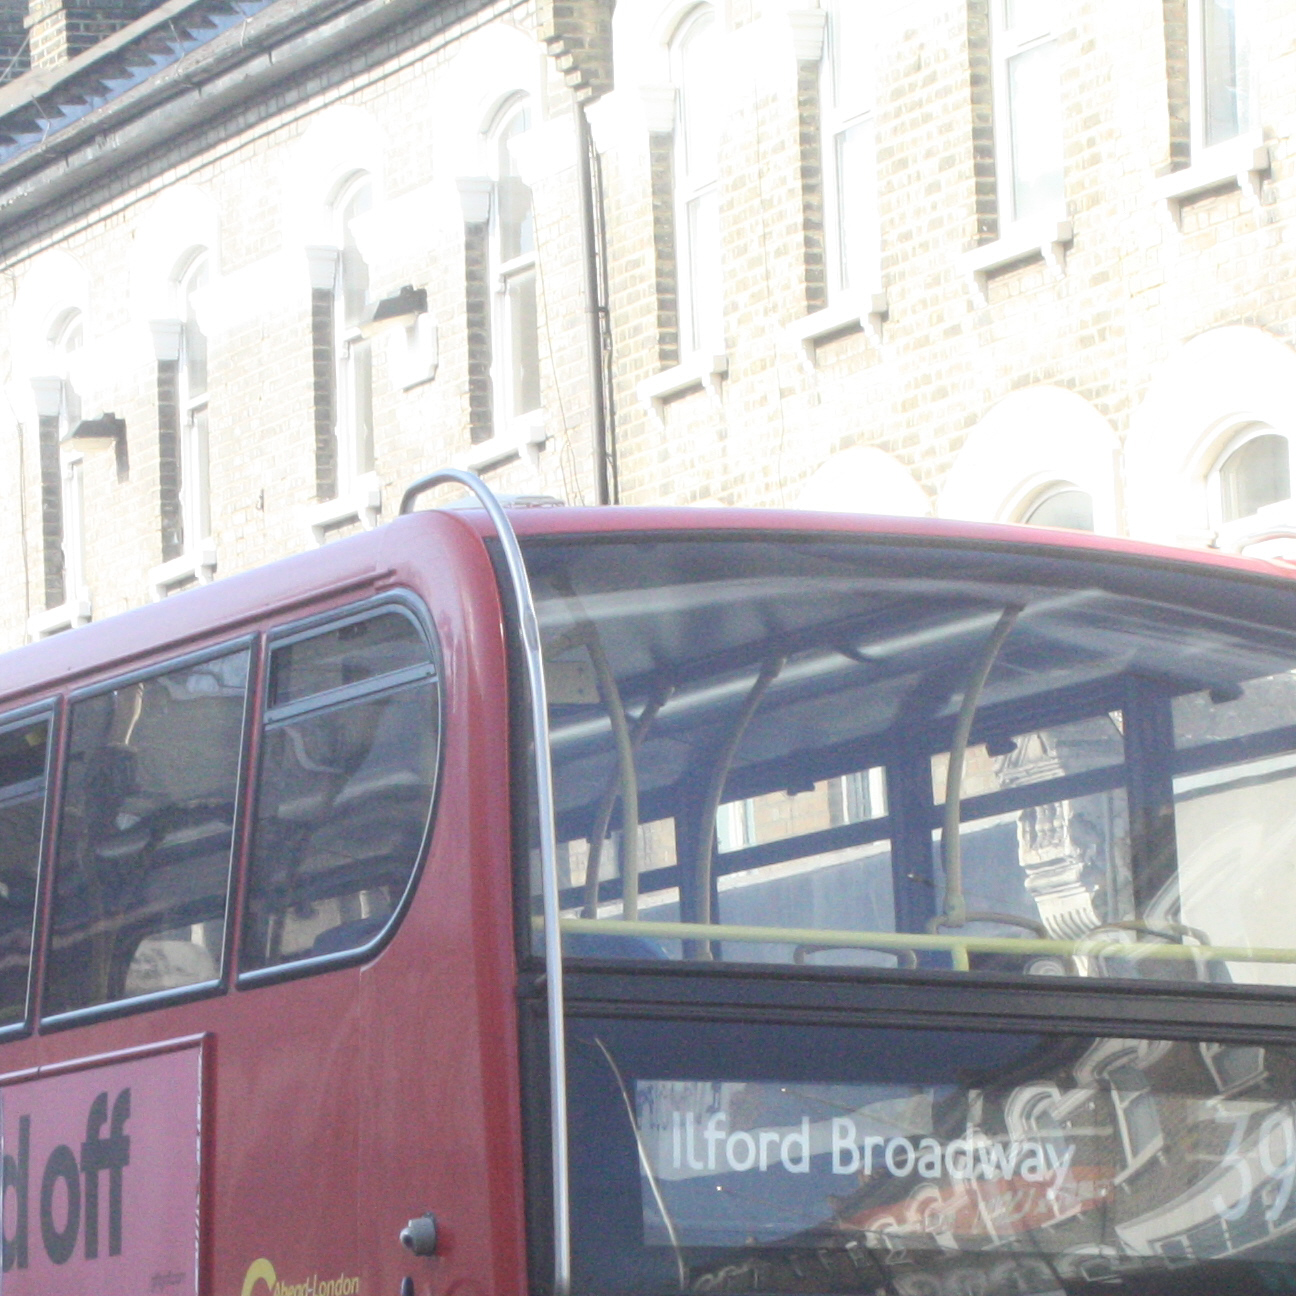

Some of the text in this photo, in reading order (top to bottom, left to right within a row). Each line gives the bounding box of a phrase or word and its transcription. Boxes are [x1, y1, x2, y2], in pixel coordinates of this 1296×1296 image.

[39, 1086, 131, 1266] off
[671, 1109, 1077, 1187] Ilford Broadway
